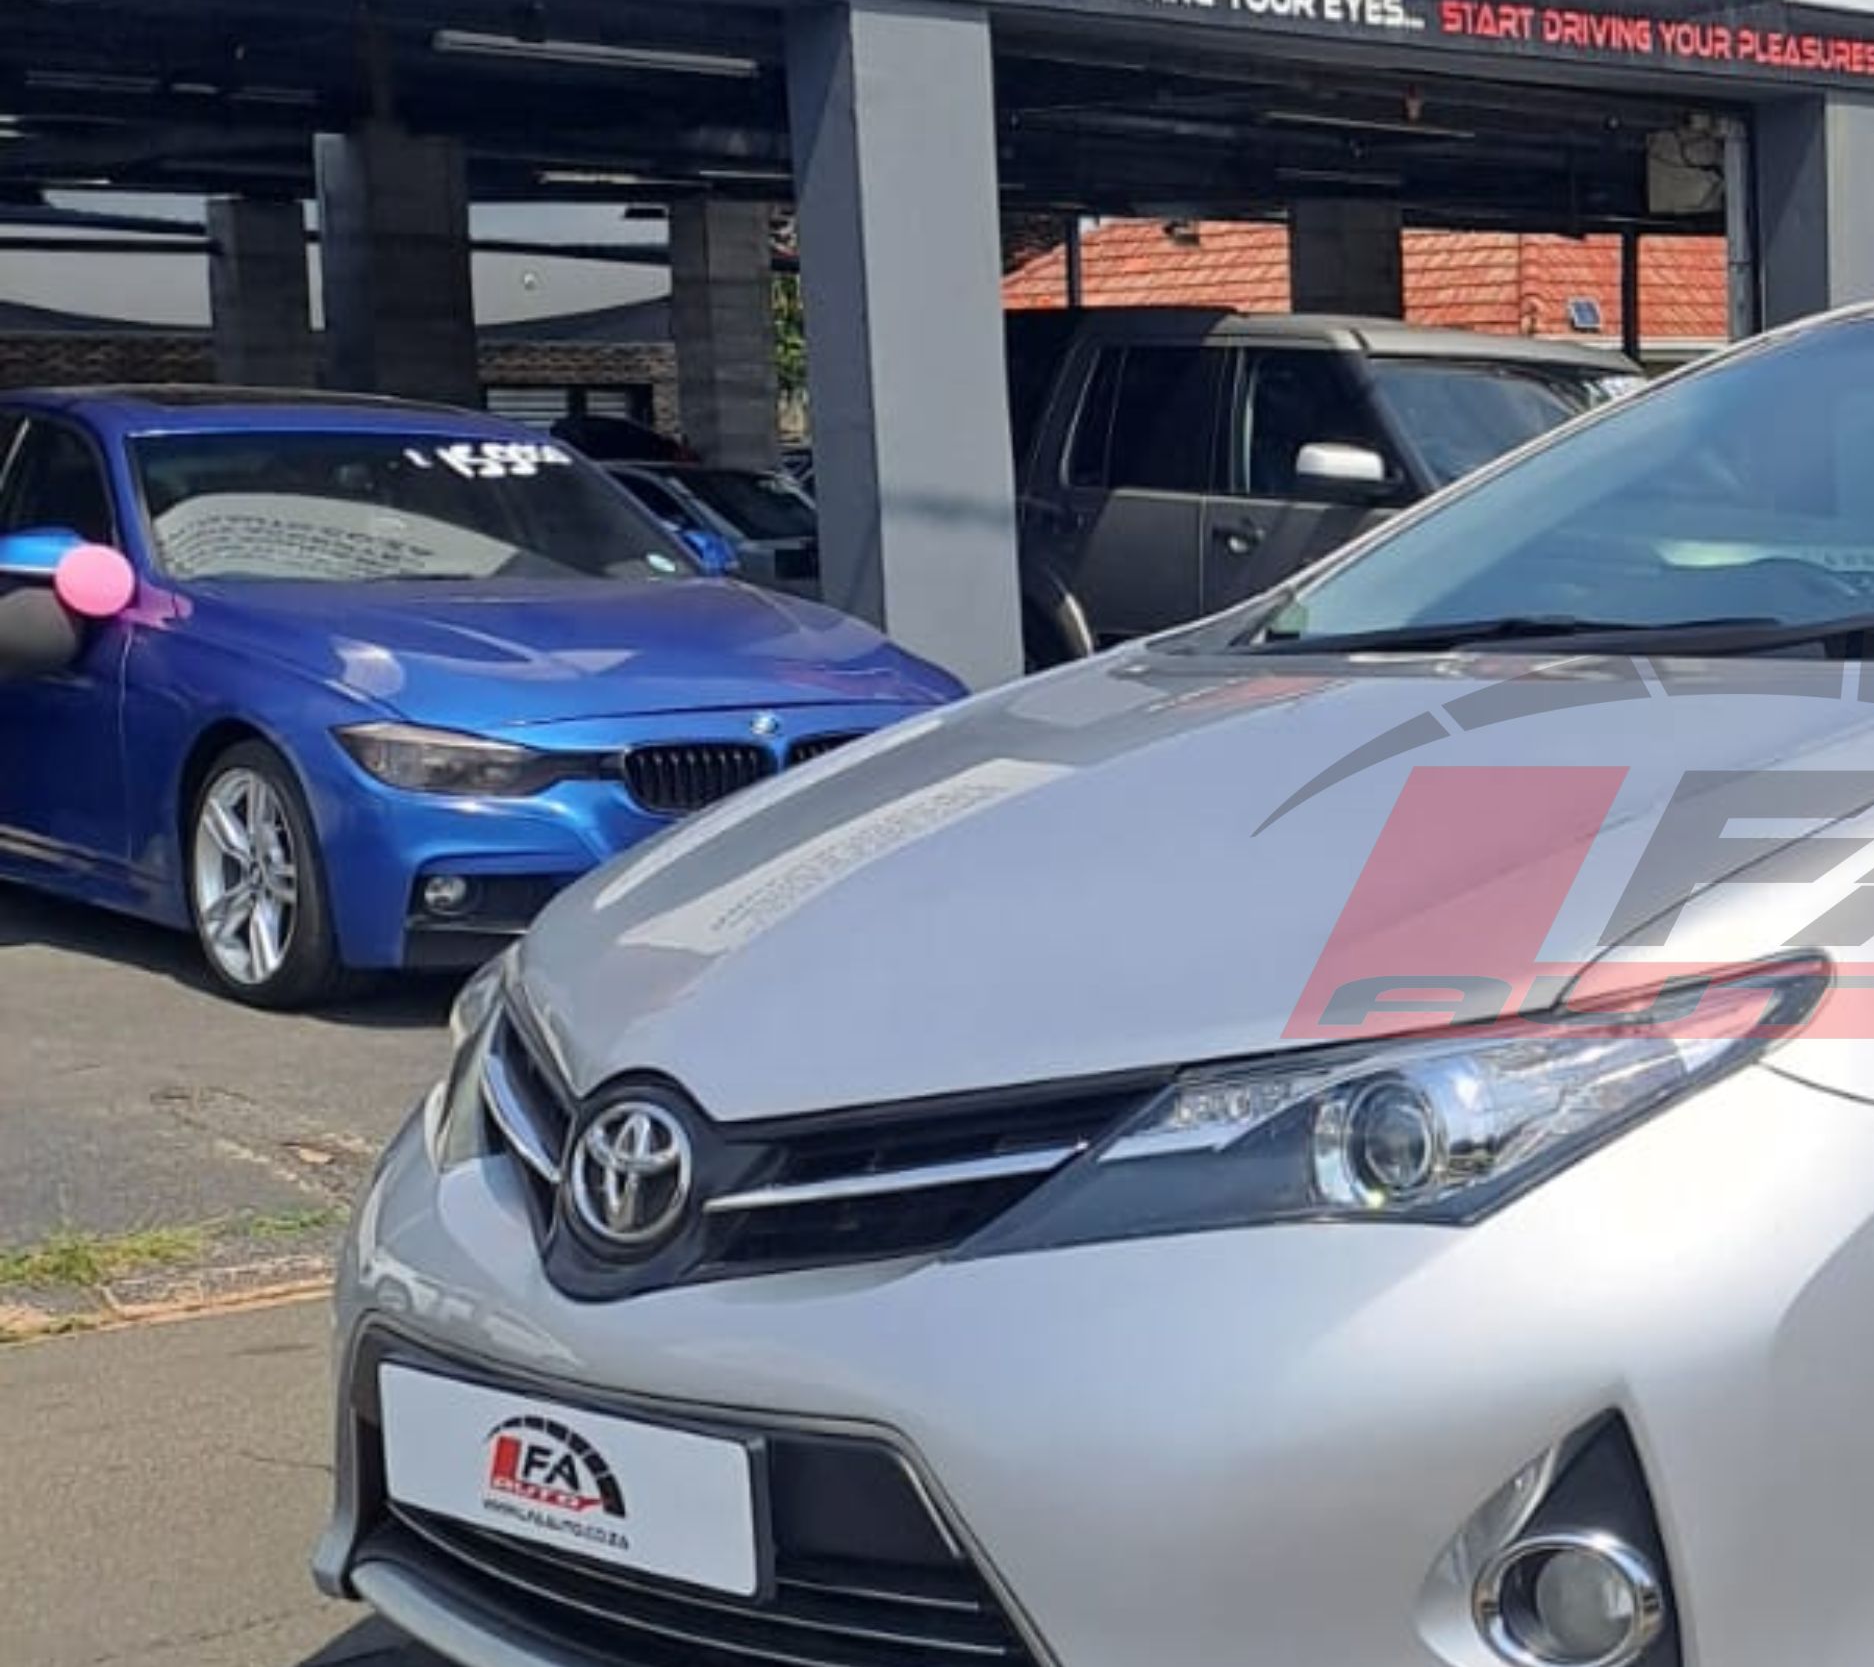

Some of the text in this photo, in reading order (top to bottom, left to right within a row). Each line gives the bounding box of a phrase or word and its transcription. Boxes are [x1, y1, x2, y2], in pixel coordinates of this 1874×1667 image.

[1542, 10, 1653, 53] DRIVING
[1658, 21, 1733, 60] YOUR
[491, 1435, 580, 1492] LFA
